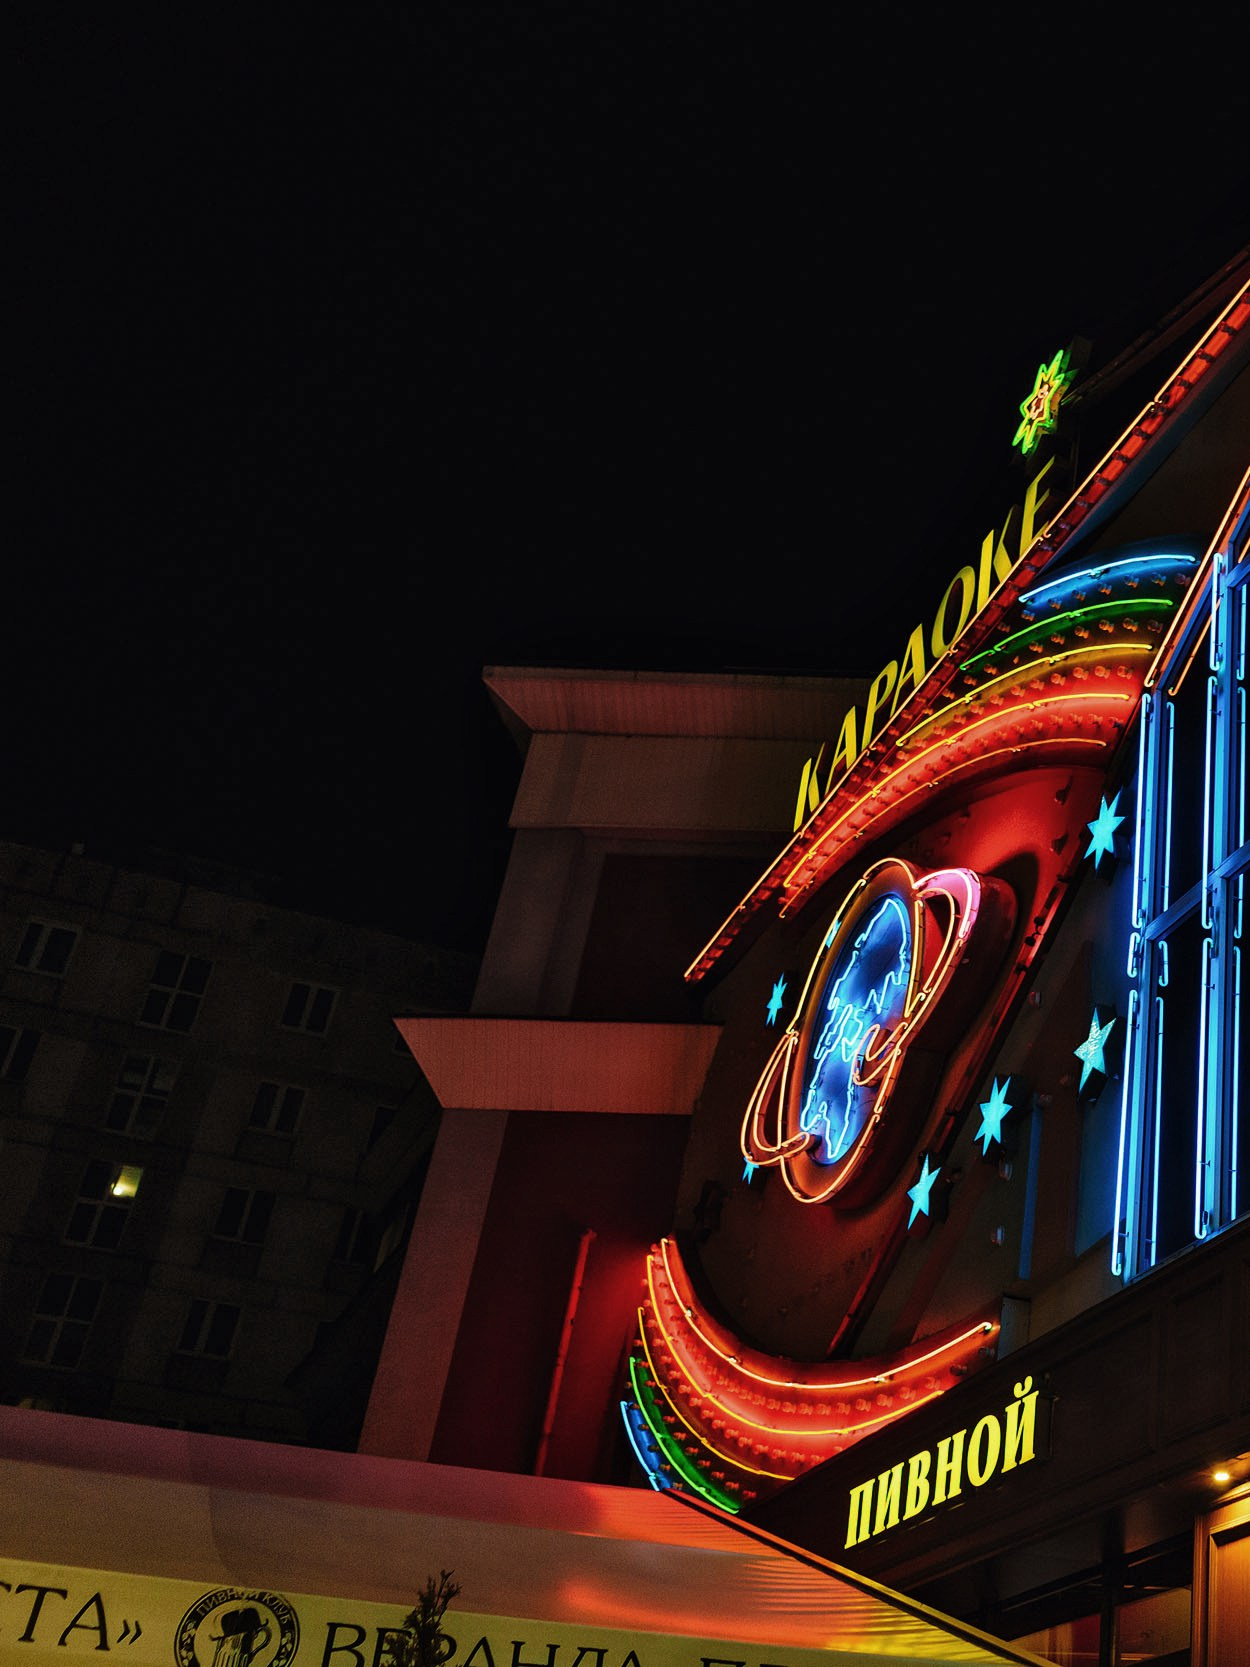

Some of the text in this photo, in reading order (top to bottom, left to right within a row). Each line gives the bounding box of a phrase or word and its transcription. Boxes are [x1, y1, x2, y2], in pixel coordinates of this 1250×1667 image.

[794, 455, 1055, 833] КАРАОКЕ
[844, 1375, 1040, 1550] ПИВНОЙ
[0, 1582, 142, 1651] ТА»
